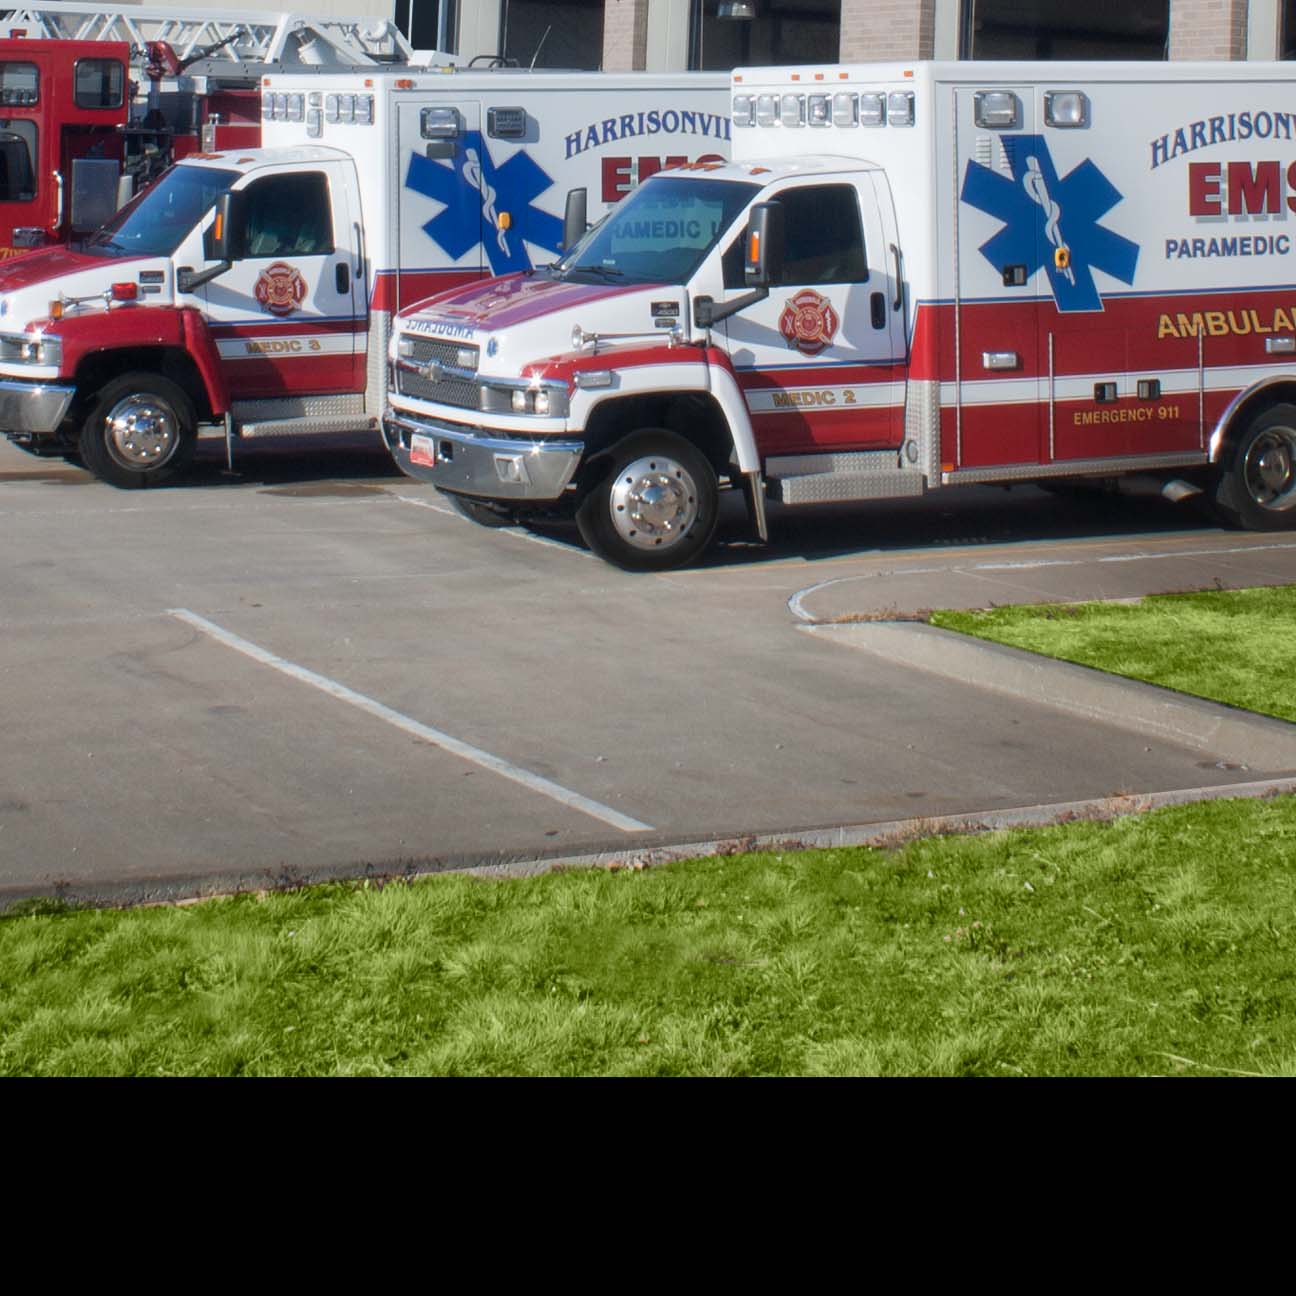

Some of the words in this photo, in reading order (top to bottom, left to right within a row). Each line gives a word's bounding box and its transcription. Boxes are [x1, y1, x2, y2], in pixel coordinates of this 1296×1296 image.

[565, 110, 731, 160] HARRISONVI
[1165, 234, 1291, 259] PARAMEDIC
[246, 339, 303, 355] MEDIC
[771, 390, 836, 407] MEDIC
[842, 389, 857, 404] 2
[1073, 407, 1153, 425] EMERGENCY
[1158, 405, 1180, 420] 911
